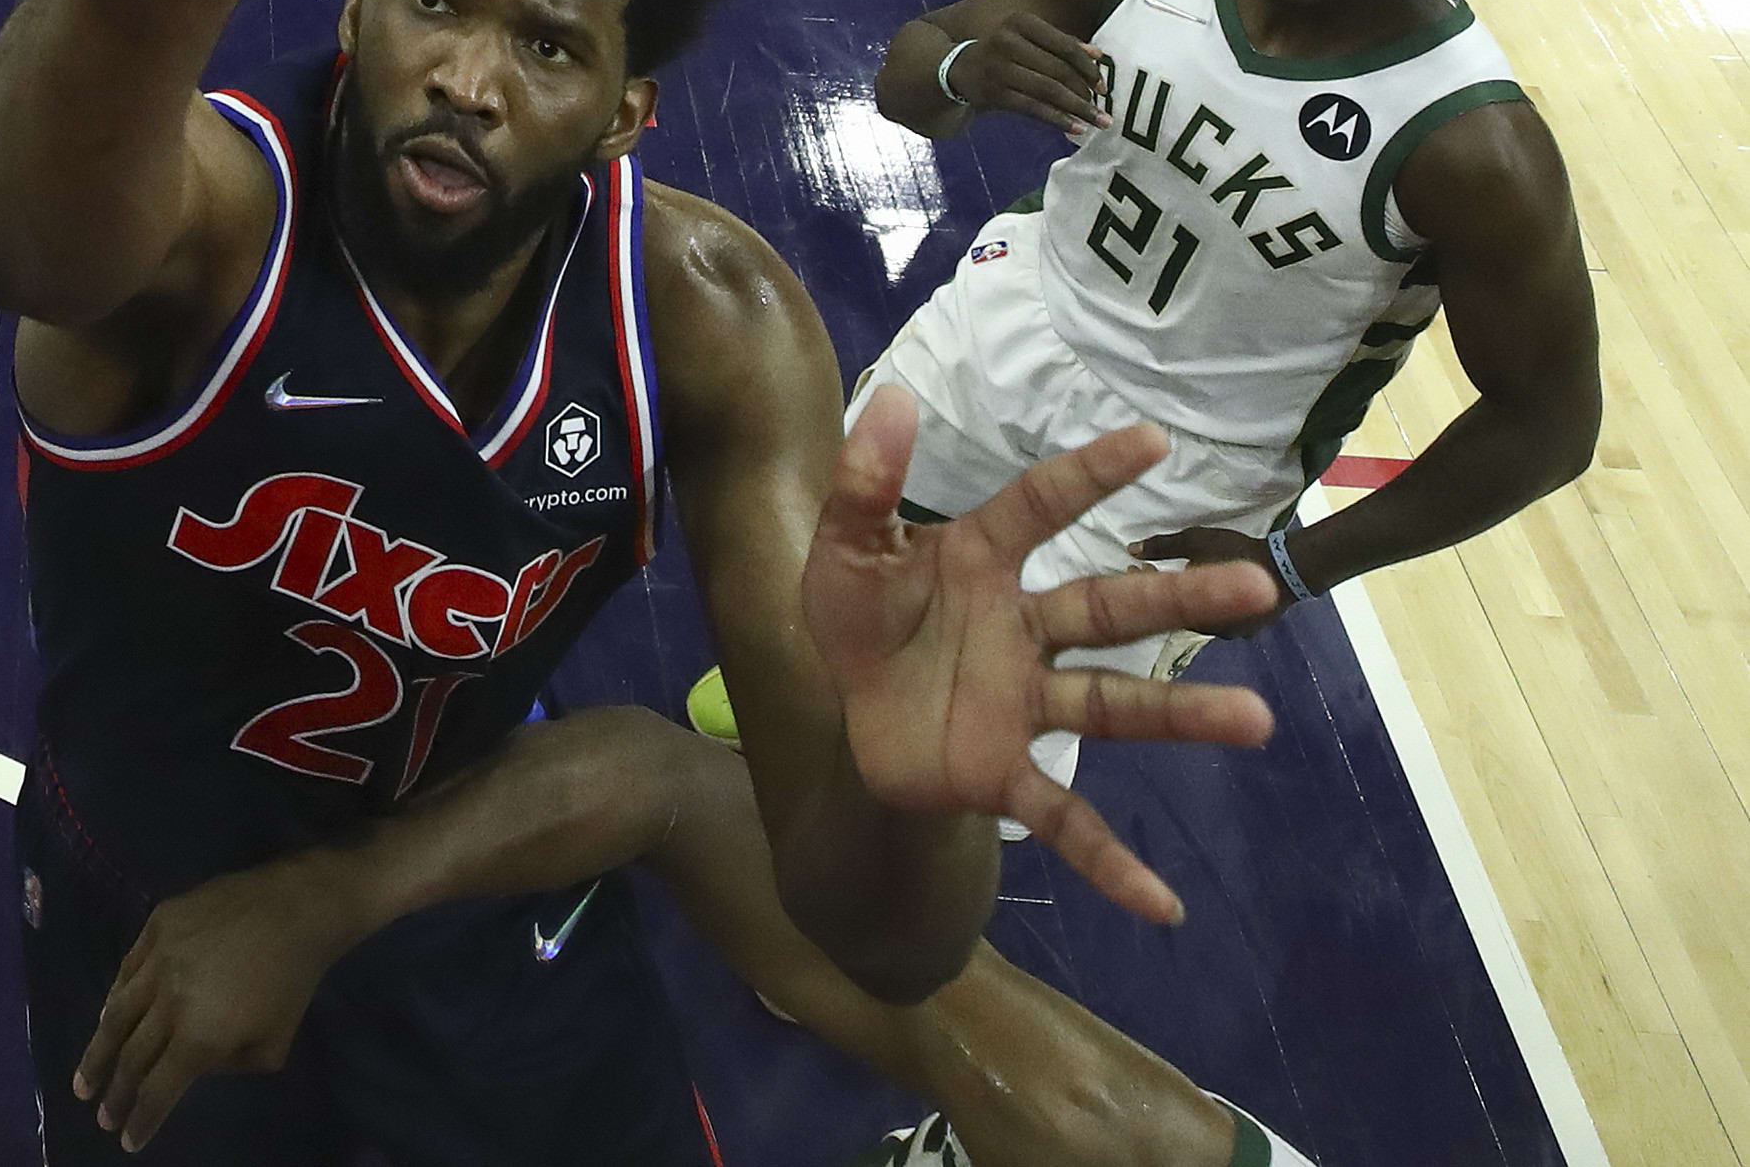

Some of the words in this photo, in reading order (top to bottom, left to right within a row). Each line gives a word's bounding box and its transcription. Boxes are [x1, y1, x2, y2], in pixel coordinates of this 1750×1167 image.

[1086, 171, 1200, 317] 21
[524, 484, 628, 514] rypto.com
[230, 620, 484, 801] 21
